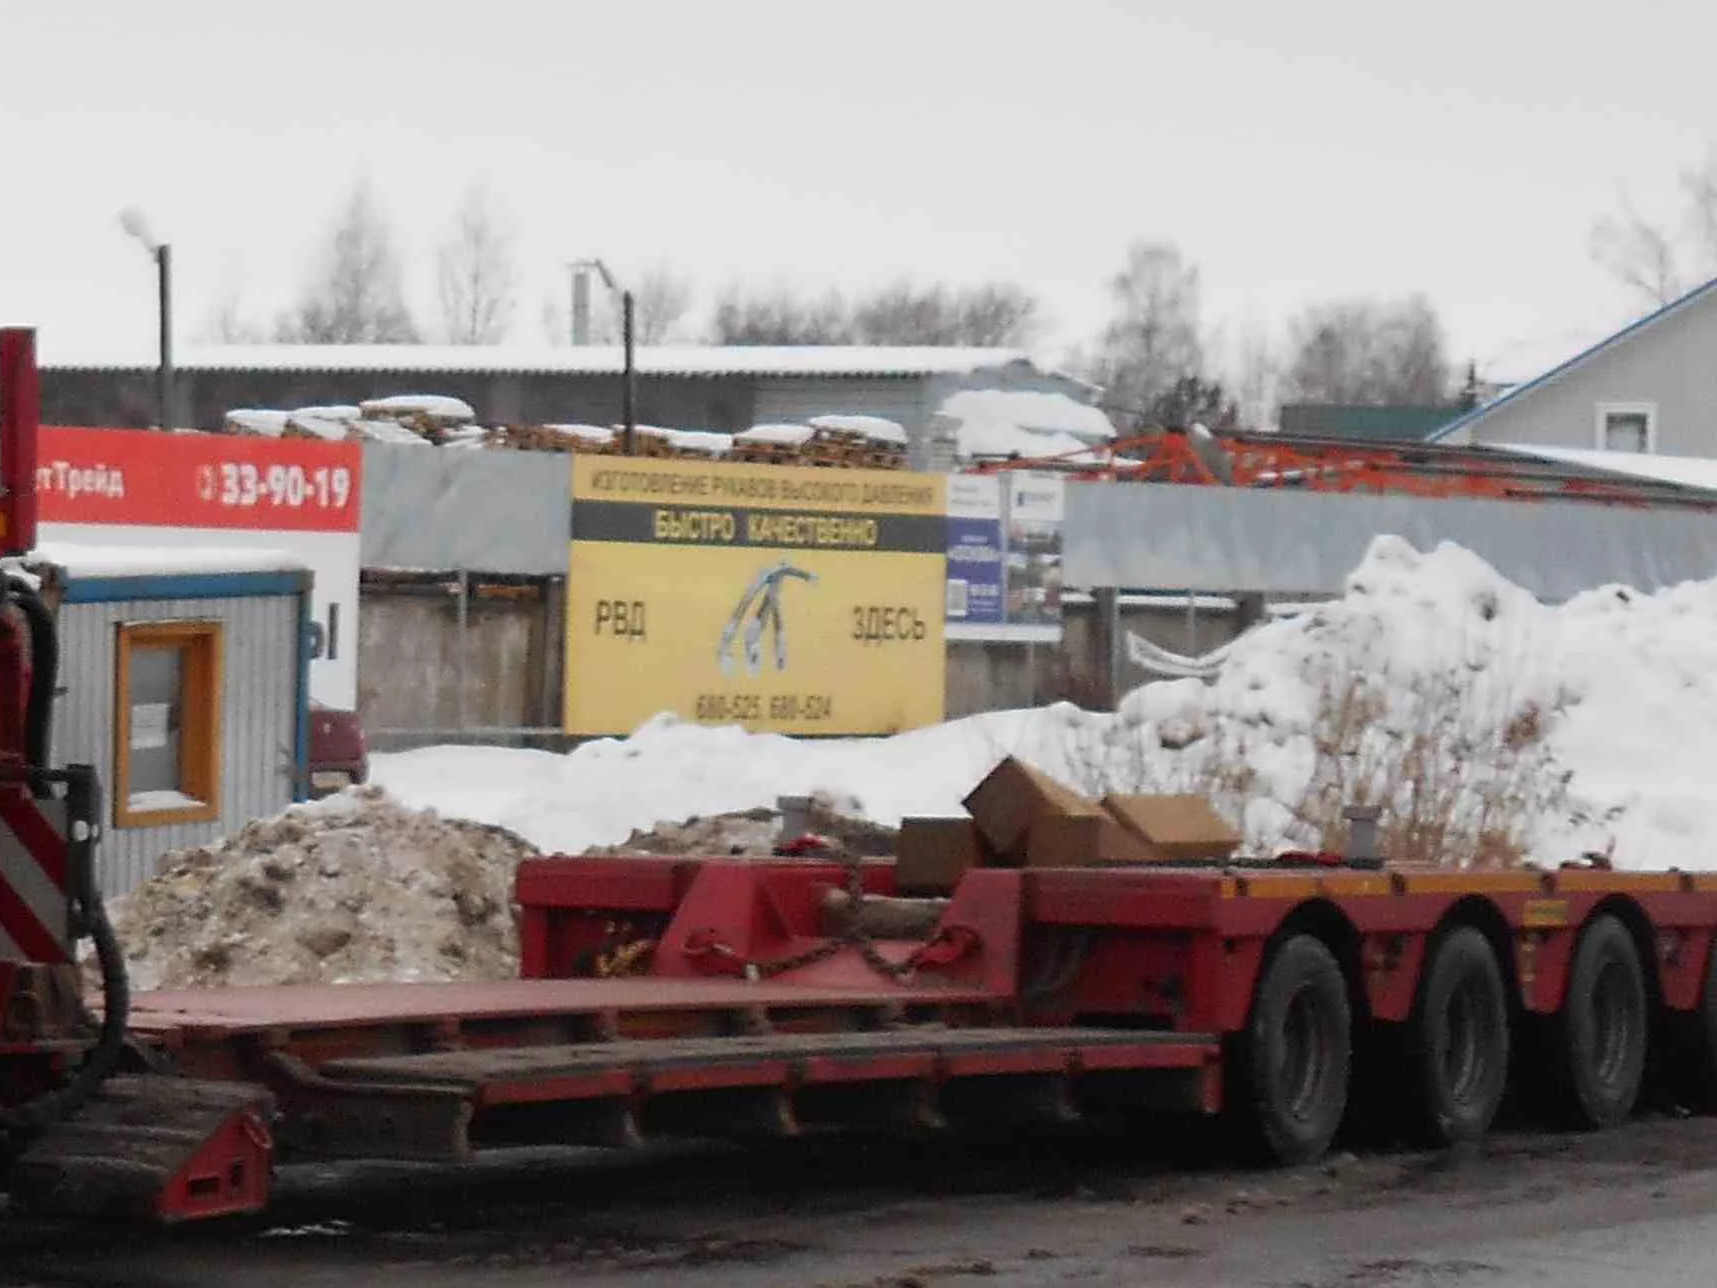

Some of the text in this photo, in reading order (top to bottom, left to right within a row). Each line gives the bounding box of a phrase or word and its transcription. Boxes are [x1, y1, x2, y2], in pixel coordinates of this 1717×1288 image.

[221, 462, 351, 508] 33-90-19
[654, 509, 879, 547] БЫСТРО КАЧЕСТВЕННО
[595, 599, 927, 644] РВД ЗДЕСЬ
